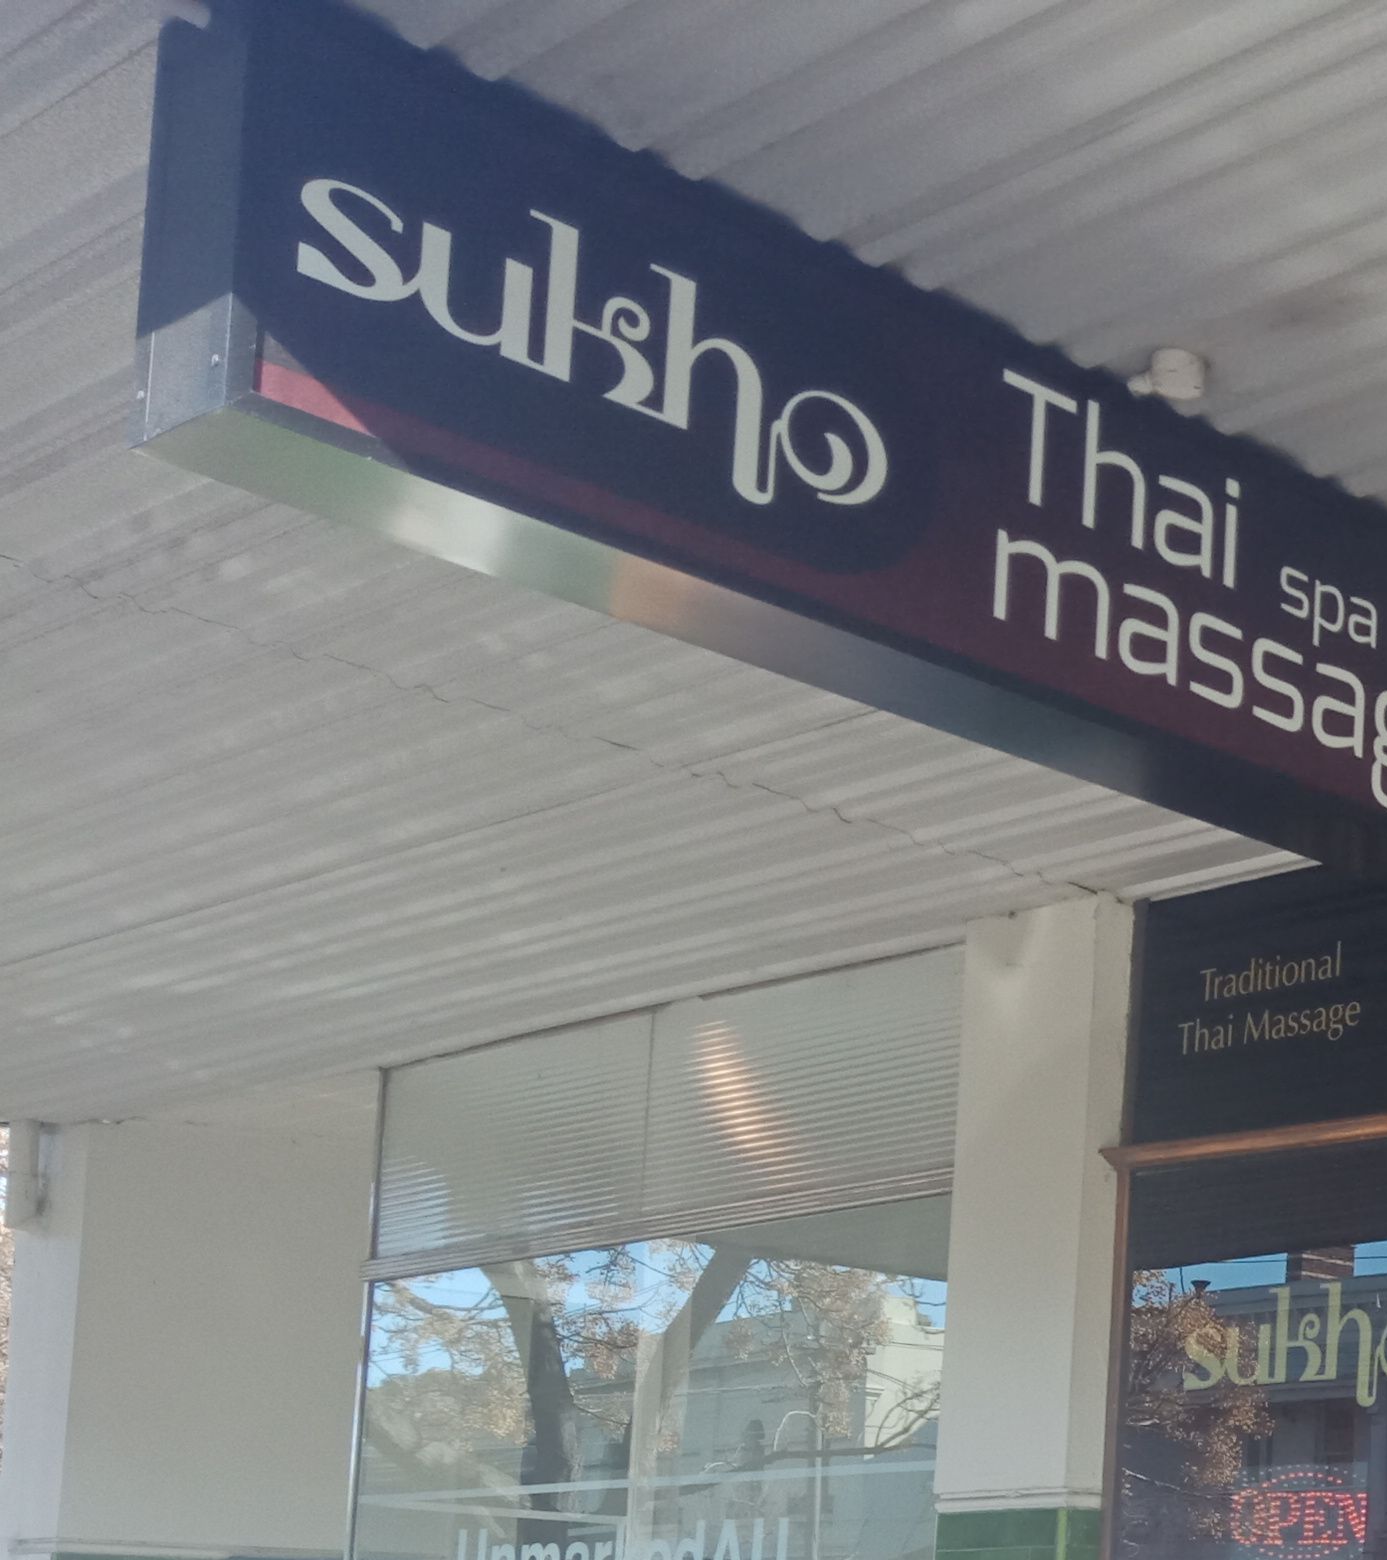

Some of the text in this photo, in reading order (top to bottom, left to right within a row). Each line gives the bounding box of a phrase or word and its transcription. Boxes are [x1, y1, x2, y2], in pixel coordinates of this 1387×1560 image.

[296, 178, 888, 505] sukho
[1002, 368, 1241, 589] Thai
[1279, 565, 1378, 647] spa
[1200, 940, 1342, 1002] Traditional
[1177, 999, 1361, 1055] Thai Massage
[1230, 1489, 1368, 1546] OPEN
